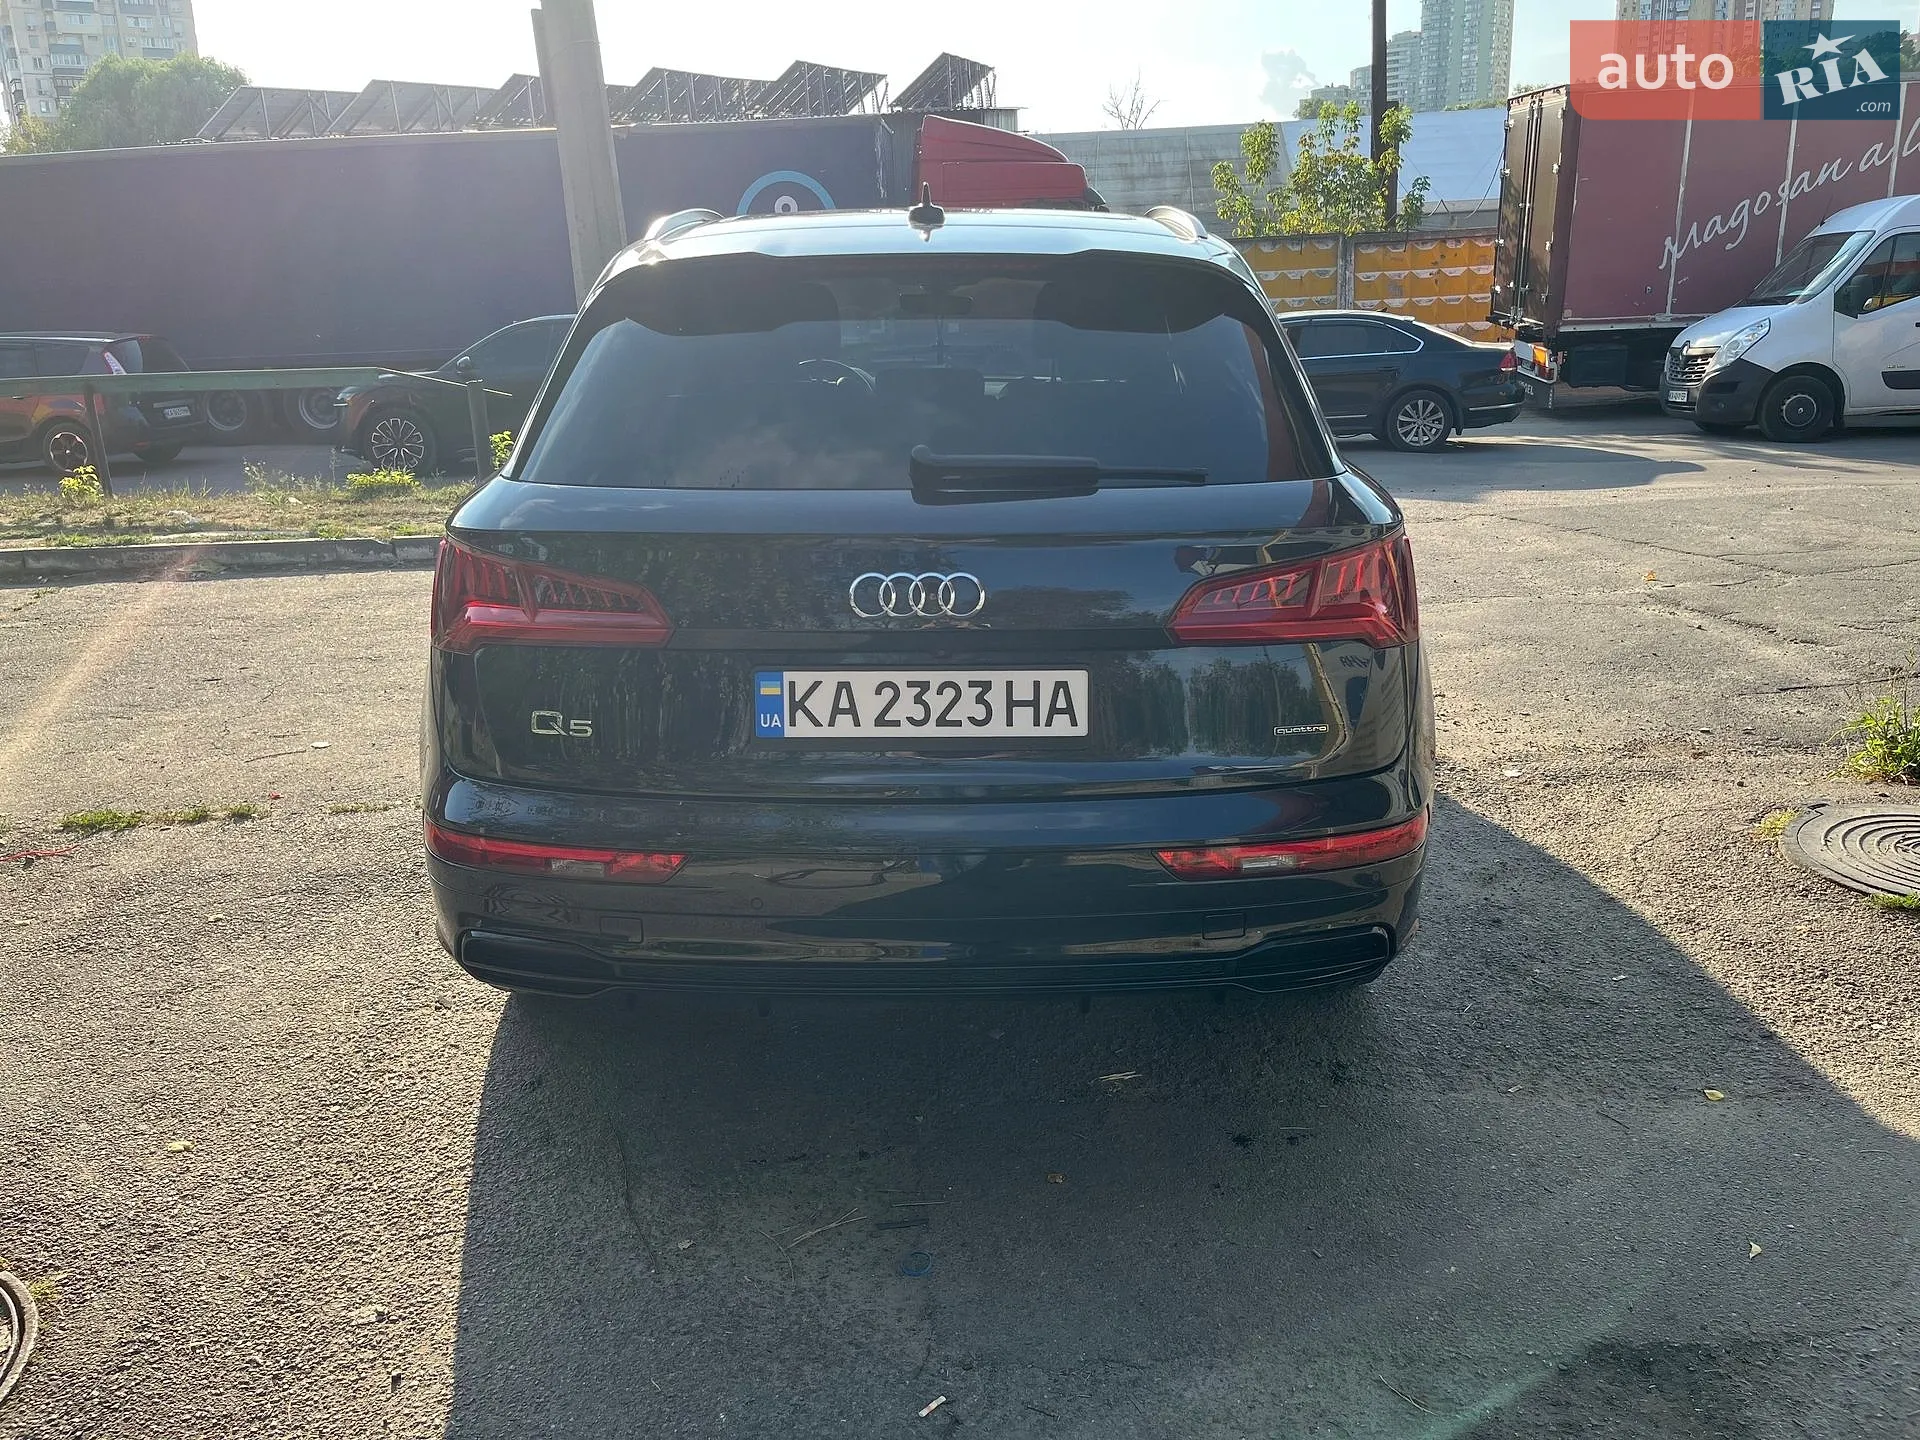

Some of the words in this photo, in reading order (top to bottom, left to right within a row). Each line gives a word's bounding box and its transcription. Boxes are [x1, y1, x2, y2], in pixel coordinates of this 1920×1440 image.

[788, 680, 862, 728] KA
[874, 680, 993, 728] 2323
[1005, 680, 1079, 728] HA
[531, 710, 593, 738] Q5
[760, 714, 782, 728] UA
[1276, 726, 1327, 735] quattro
